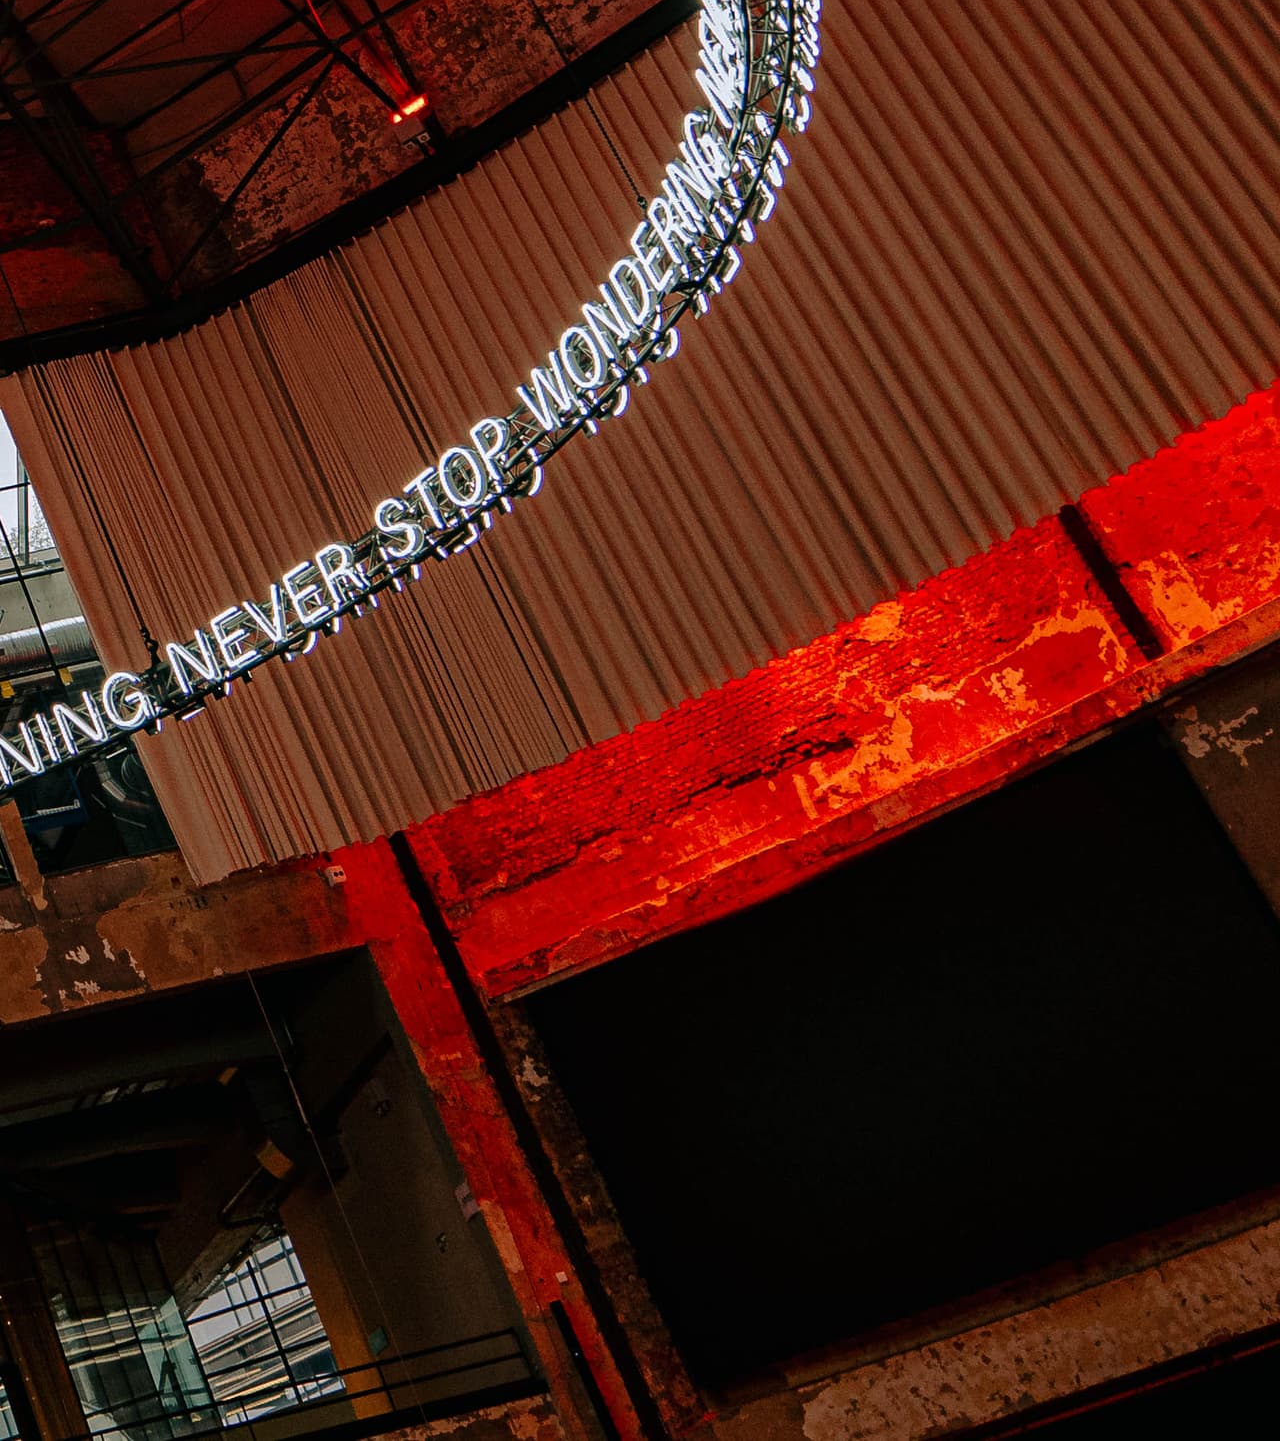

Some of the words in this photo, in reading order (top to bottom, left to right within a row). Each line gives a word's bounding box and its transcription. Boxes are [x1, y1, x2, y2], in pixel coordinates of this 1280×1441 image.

[166, 542, 367, 695] NEVER
[374, 416, 509, 558] STOP
[516, 111, 738, 432] WONDERING
